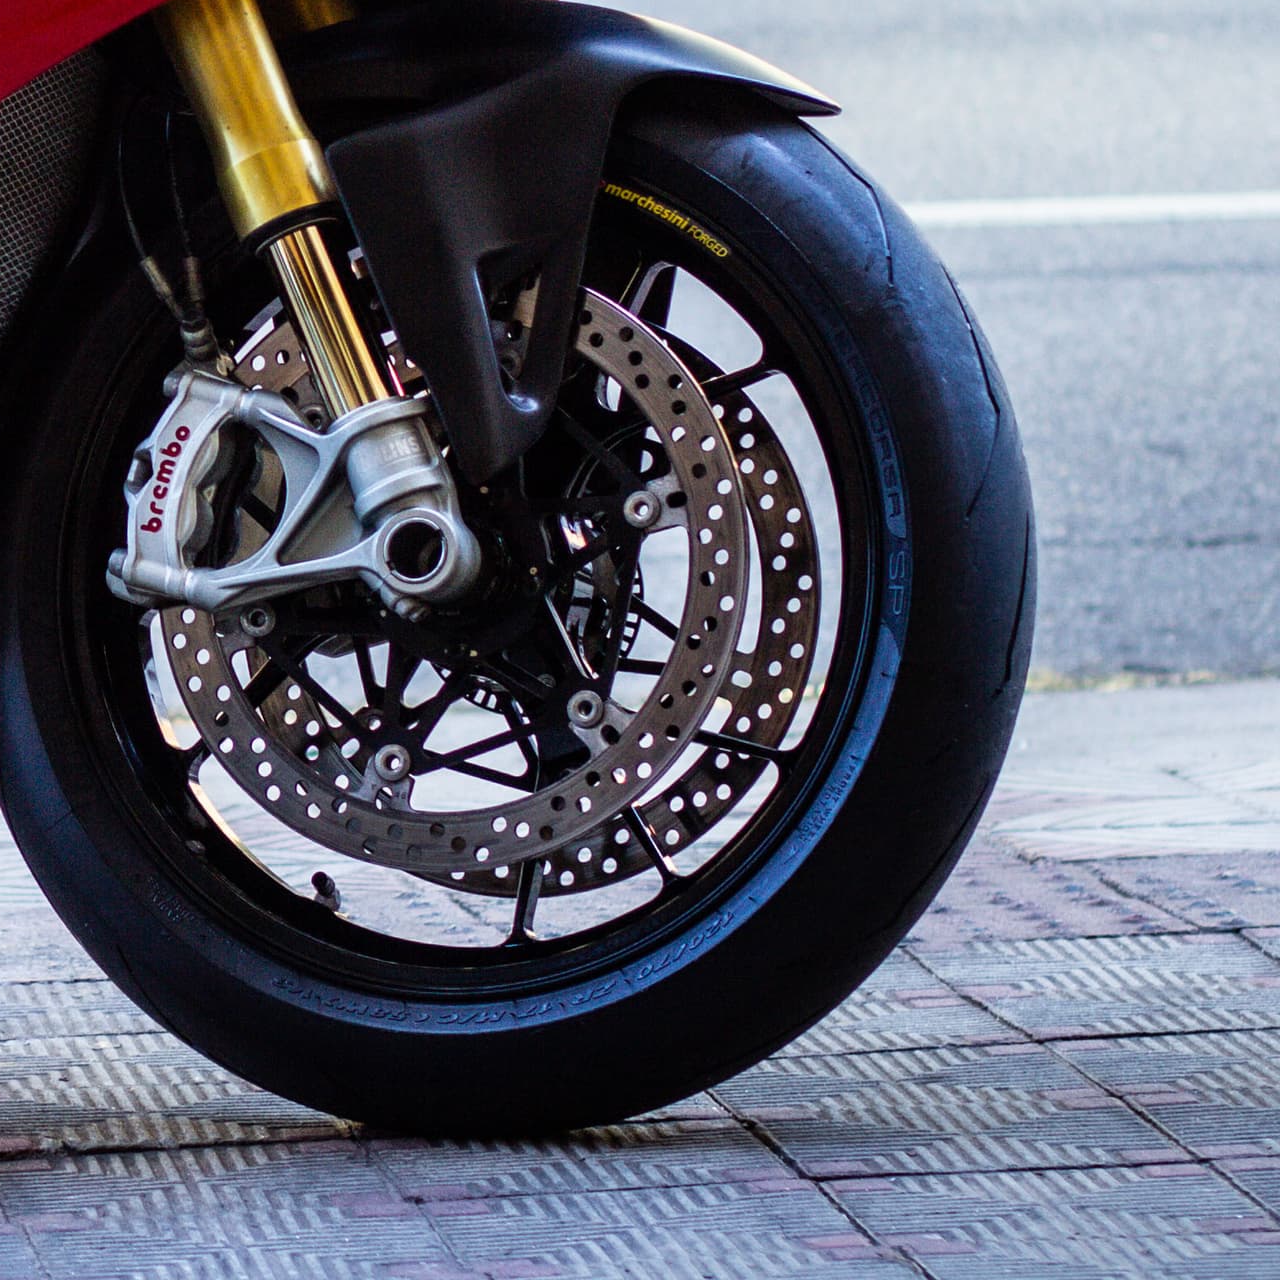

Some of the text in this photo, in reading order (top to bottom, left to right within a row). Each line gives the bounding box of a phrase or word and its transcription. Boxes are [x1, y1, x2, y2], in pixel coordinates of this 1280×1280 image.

[604, 183, 728, 257] marchesini FORGED
[140, 426, 190, 533] brembo
